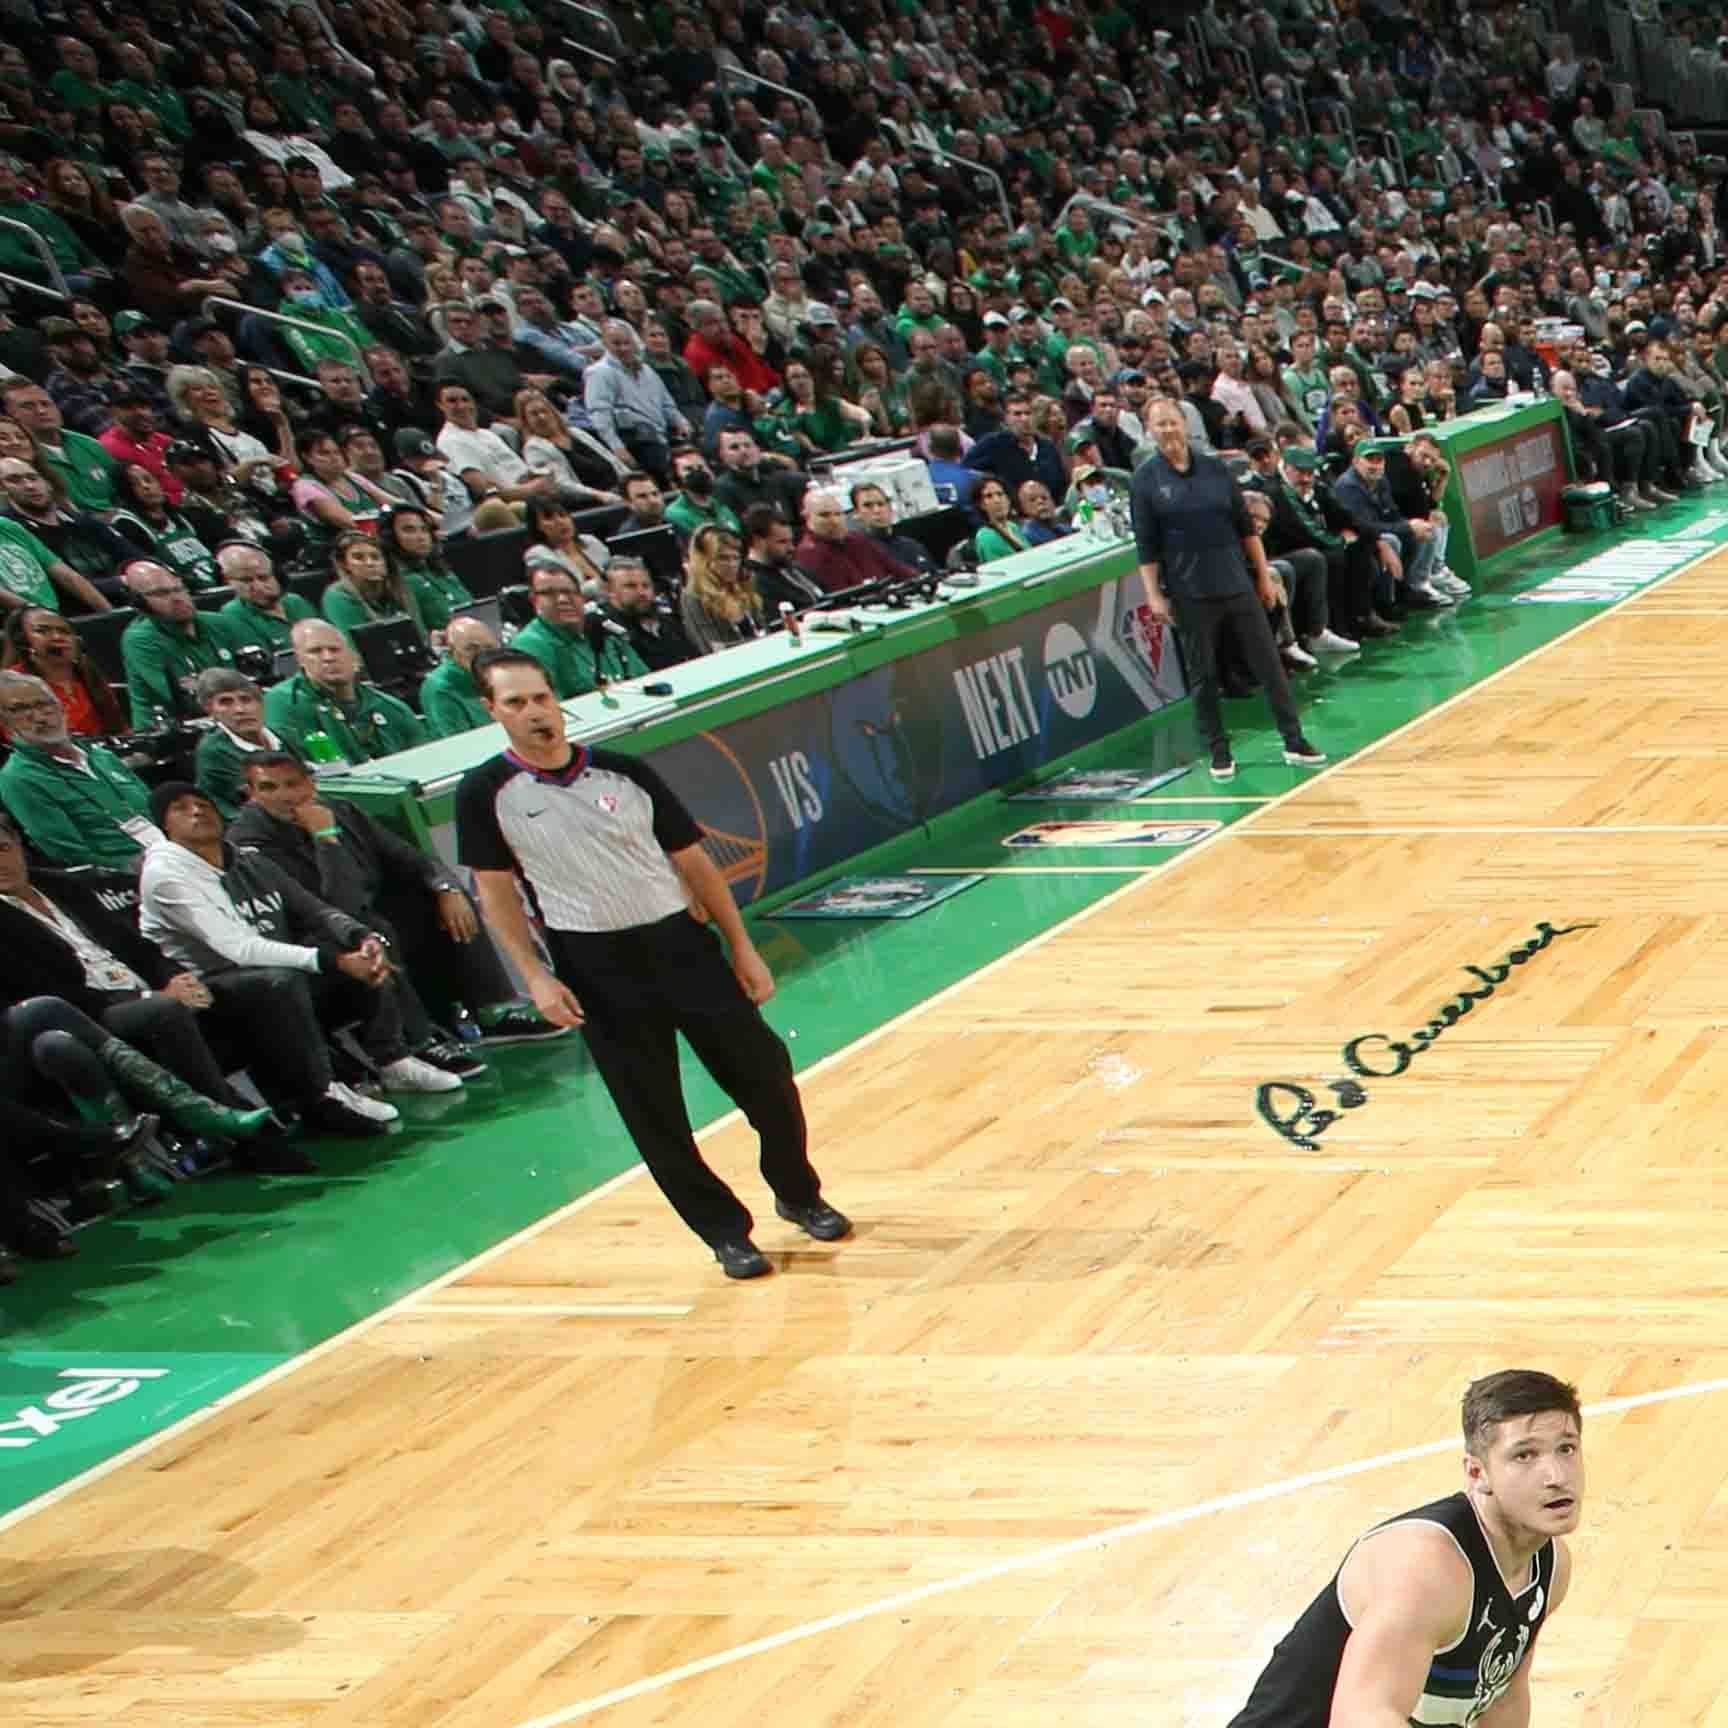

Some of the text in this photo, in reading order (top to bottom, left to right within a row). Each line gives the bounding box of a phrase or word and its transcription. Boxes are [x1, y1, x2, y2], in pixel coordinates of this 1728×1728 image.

[952, 646, 1041, 761] NEXT
[1046, 655, 1097, 698] TNT
[768, 751, 824, 830] VS
